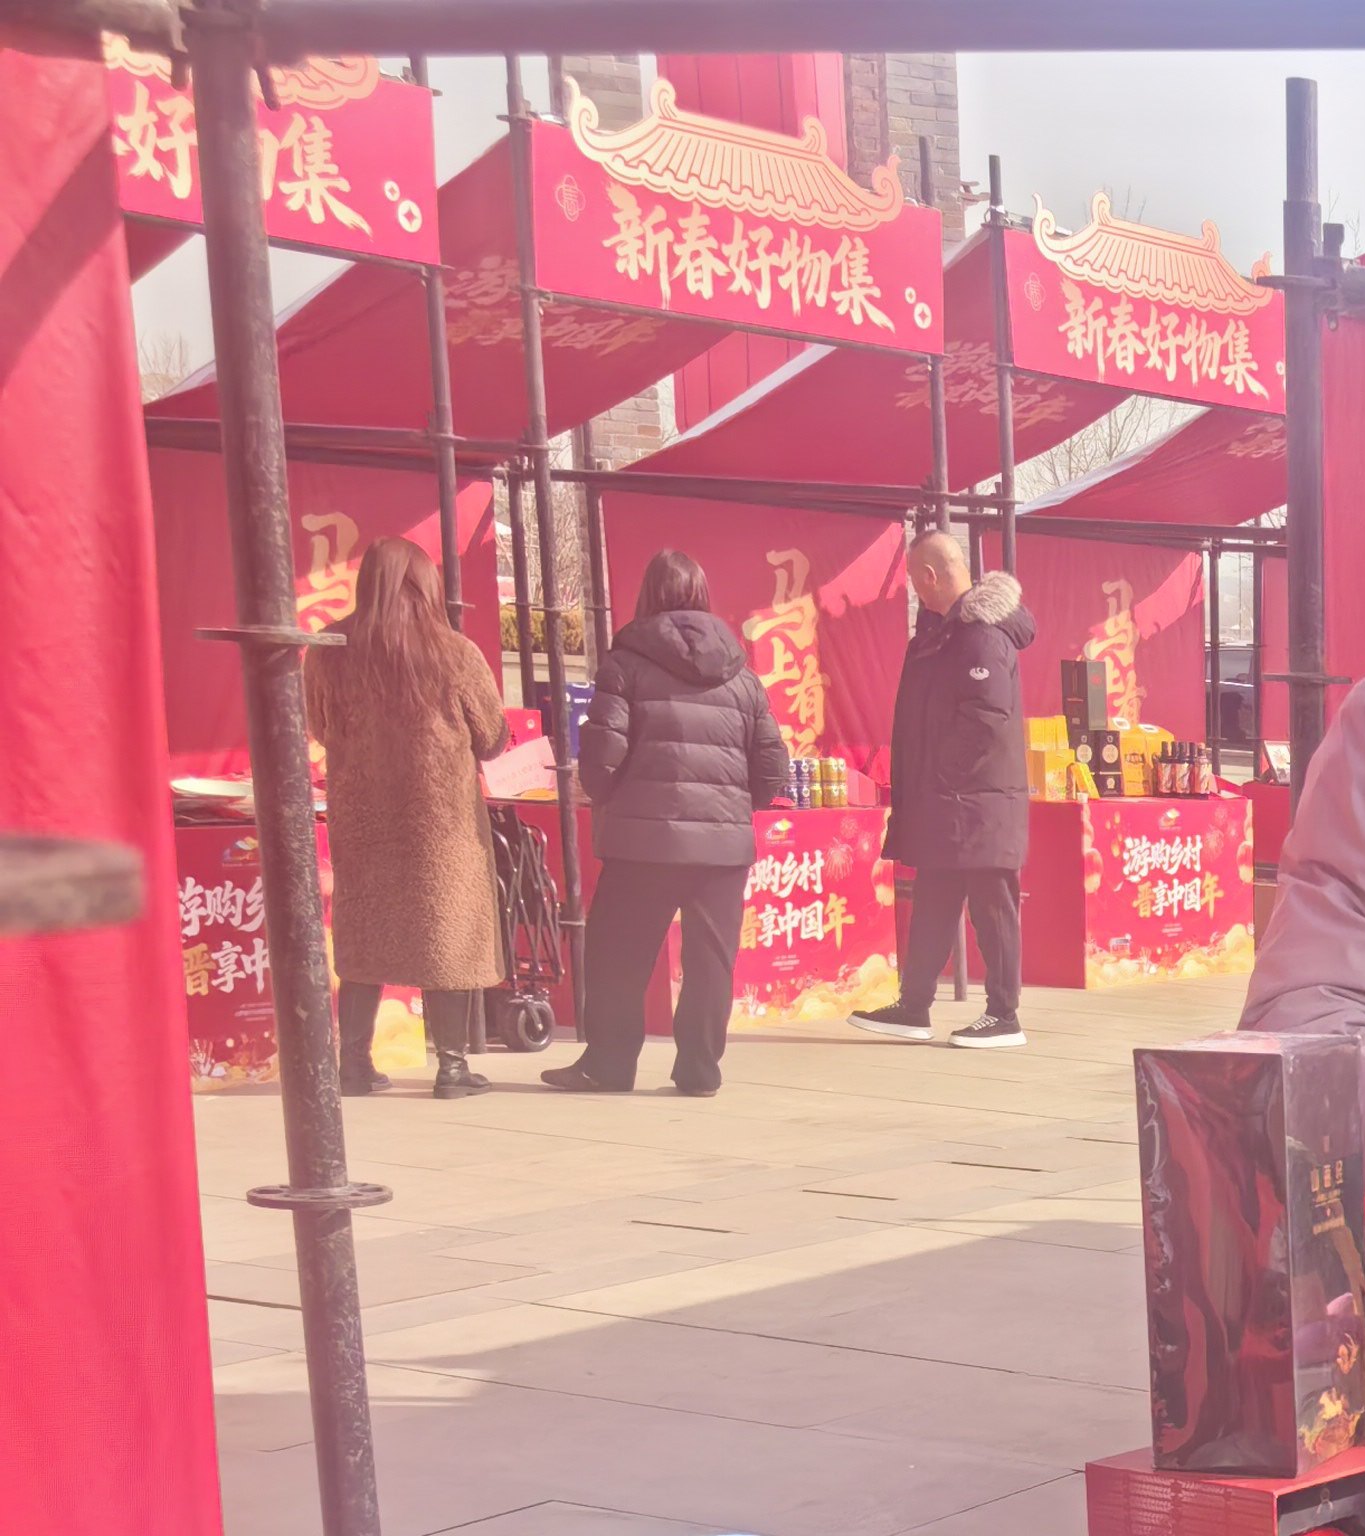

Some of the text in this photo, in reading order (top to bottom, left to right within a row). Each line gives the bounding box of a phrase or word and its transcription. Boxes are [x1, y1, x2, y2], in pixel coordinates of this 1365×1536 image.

[602, 182, 895, 333] 新春好物集
[1058, 277, 1270, 401] 新春好物集
[1122, 834, 1203, 880] 游购乡村
[1132, 871, 1225, 920] 晋享中国年
